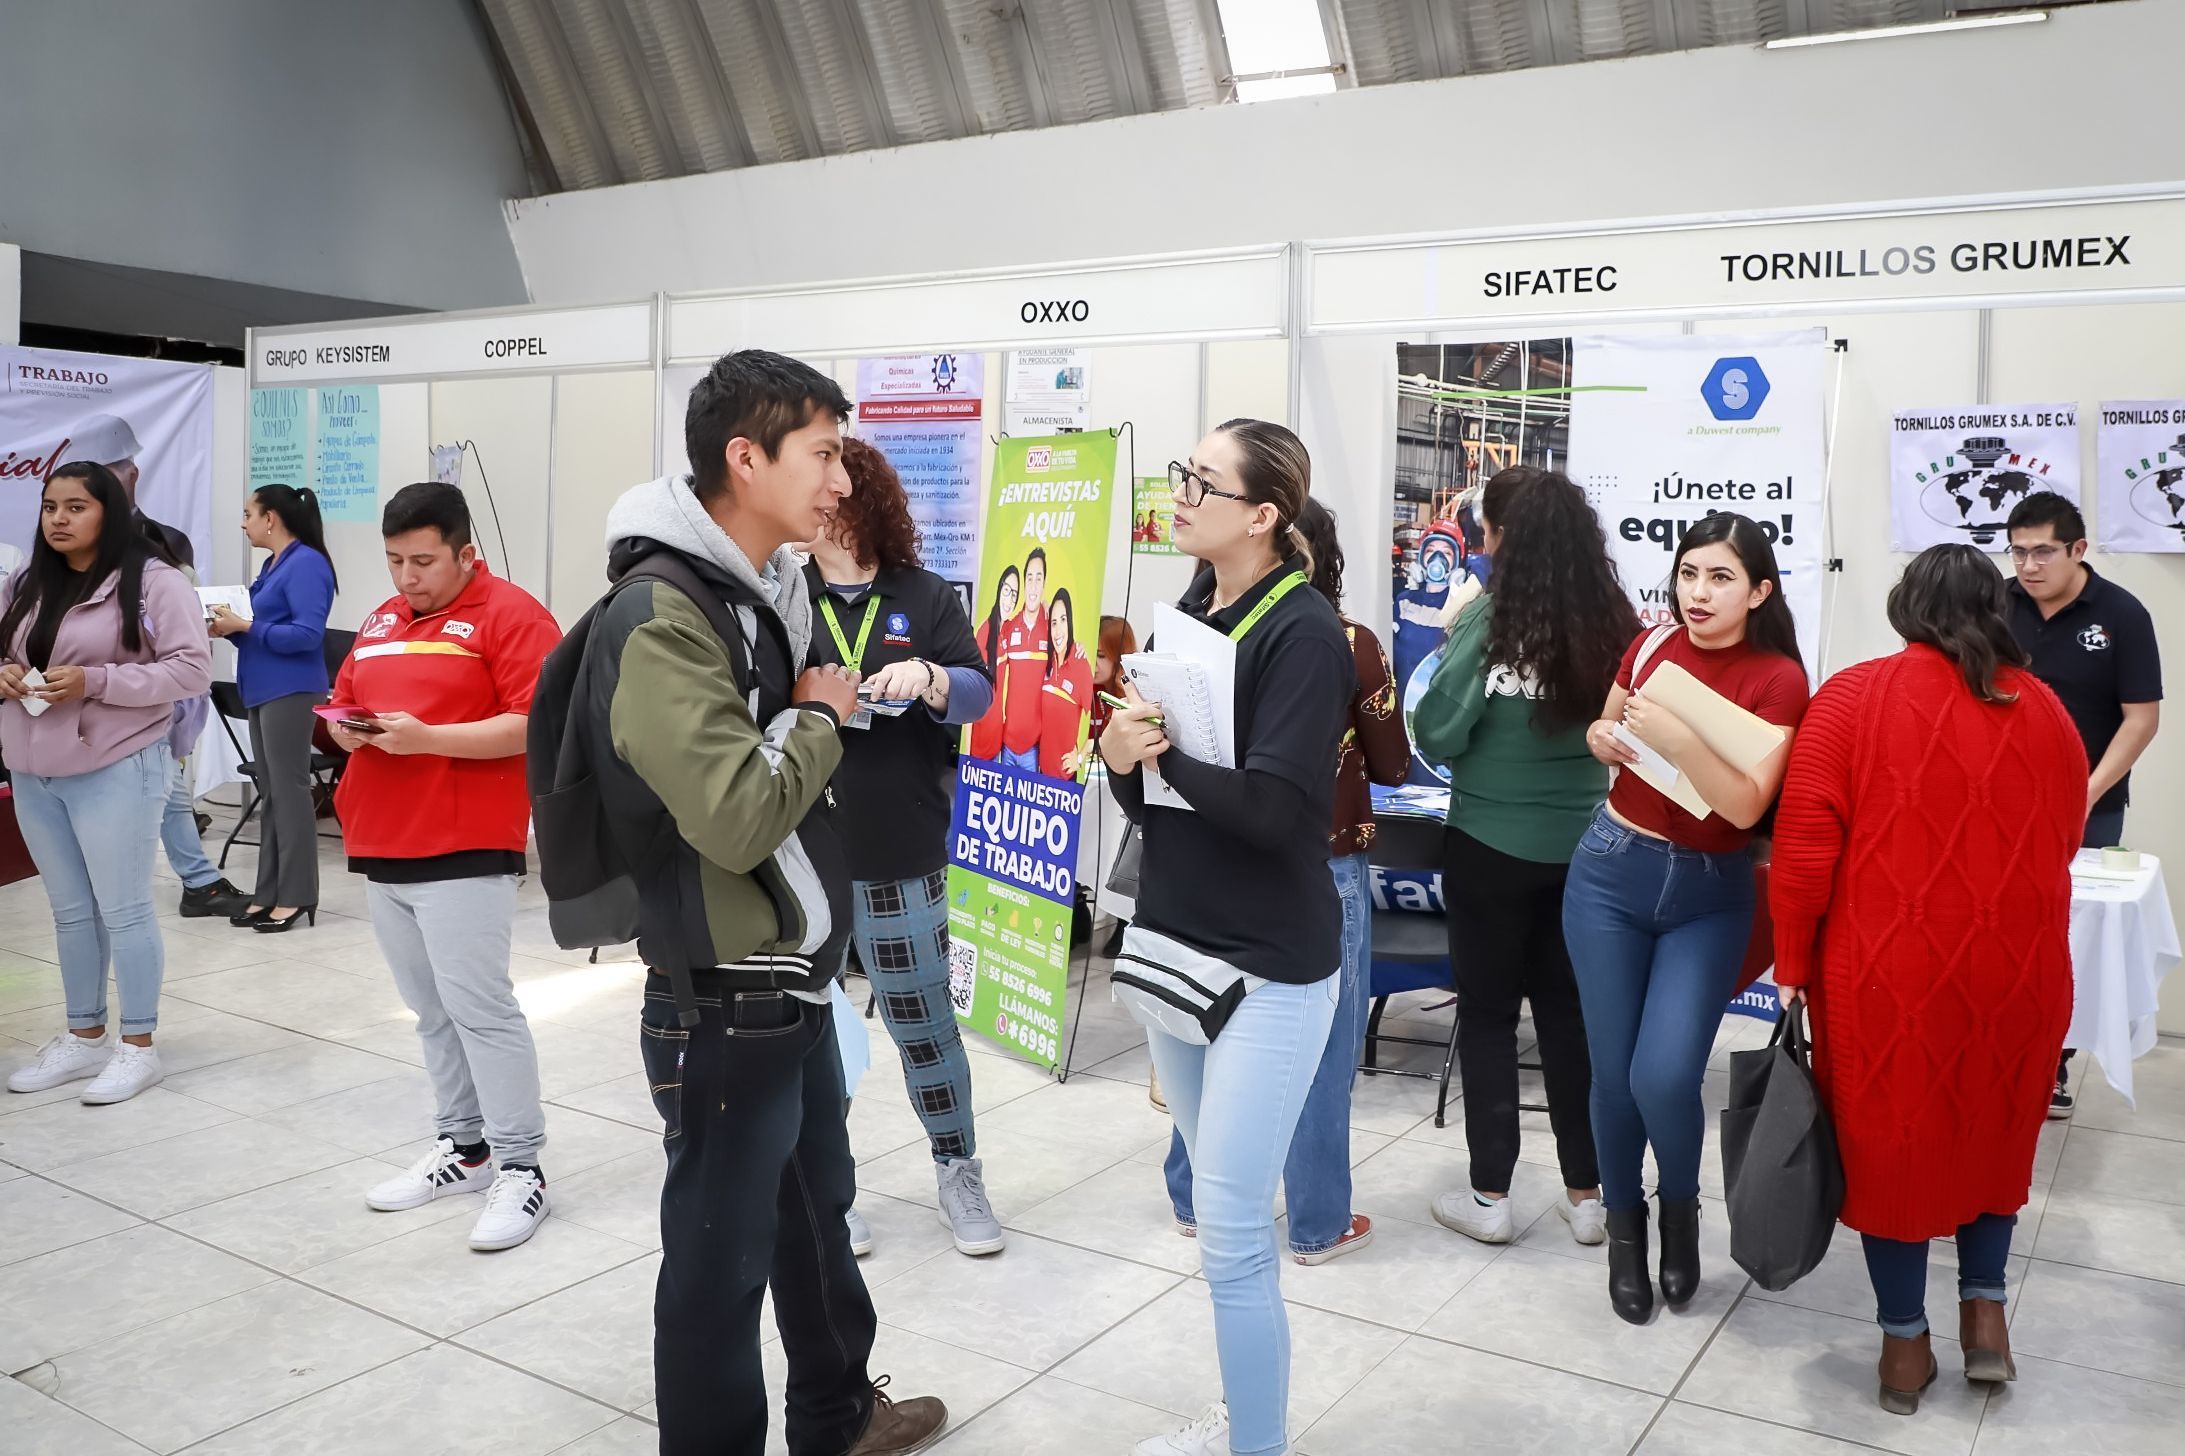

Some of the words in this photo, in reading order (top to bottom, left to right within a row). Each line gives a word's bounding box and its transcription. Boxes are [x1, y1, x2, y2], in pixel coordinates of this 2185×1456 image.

[1720, 246, 1936, 282] TORNILLOS
[1950, 235, 2132, 272] GRUMEX
[1483, 265, 1617, 297] SIFATEC
[1021, 299, 1089, 323] OXXO
[266, 349, 307, 368] GRUPO
[316, 345, 390, 363] KEYSISTEM
[485, 337, 547, 358] COPPEL
[18, 365, 109, 386] TRABAJO
[1022, 416, 1073, 425] ALMACENISTA
[1894, 415, 1955, 431] TORNILLOS
[1958, 413, 2007, 429] GRUMEX
[2010, 413, 2033, 428] S.A.
[2036, 413, 2052, 427] DE
[2054, 412, 2076, 426] C.V.
[2102, 409, 2169, 425] TORNILLOS
[904, 434, 928, 442] empresa
[1695, 425, 1734, 436] Duwest
[1735, 425, 1782, 437] company
[998, 479, 1102, 508] ¡ENTREVISTAS
[1653, 472, 1756, 504] ¡Únete
[1766, 476, 1793, 500] al
[1020, 504, 1077, 544] AQUÍ!
[884, 632, 911, 643] Sifatec
[961, 760, 1003, 795] ÚNETE
[1003, 776, 1015, 797] A
[1017, 777, 1081, 816] NUESTRO
[966, 790, 1069, 858] EQUIPO
[956, 832, 979, 867] DE
[984, 839, 1071, 898] TRABAJO
[983, 945, 1002, 963] Inicia
[1001, 954, 1009, 966] tu
[988, 965, 1001, 982] 55
[1026, 981, 1053, 1008] 6996
[998, 992, 1059, 1037] LLÁMANOS:
